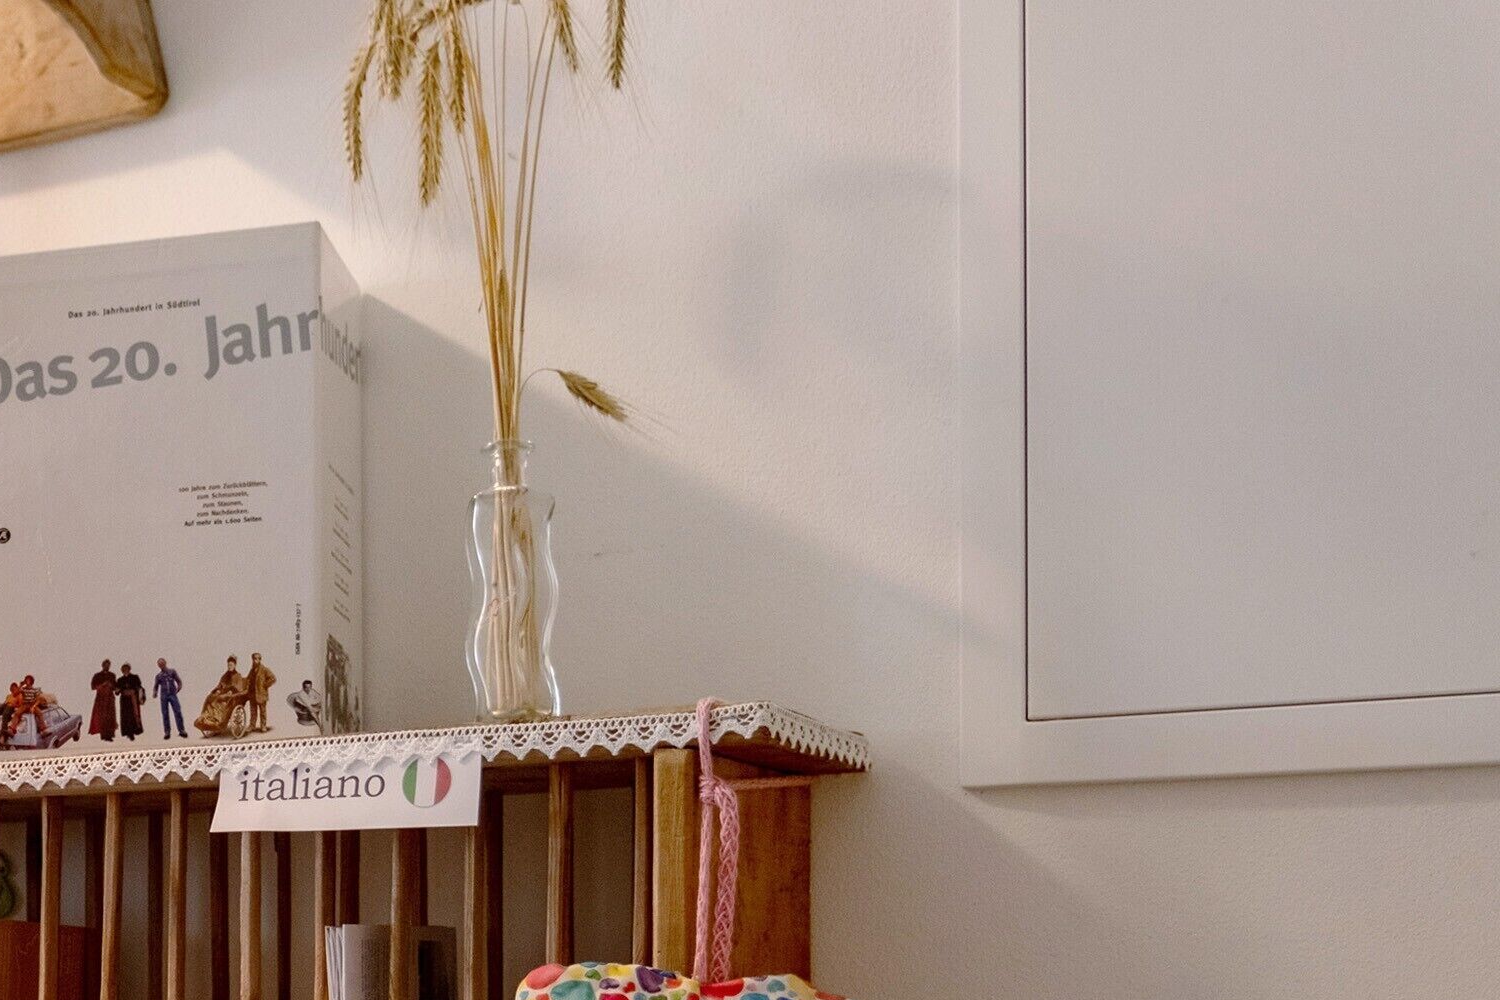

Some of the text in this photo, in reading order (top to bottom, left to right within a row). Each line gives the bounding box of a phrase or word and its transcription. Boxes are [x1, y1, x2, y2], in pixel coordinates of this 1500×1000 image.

[68, 310, 83, 319] Das
[103, 304, 152, 316] Jahrhundert
[155, 302, 164, 310] in
[167, 299, 200, 309] Südtirol
[88, 340, 178, 390] 20.
[238, 767, 386, 802] italiano
